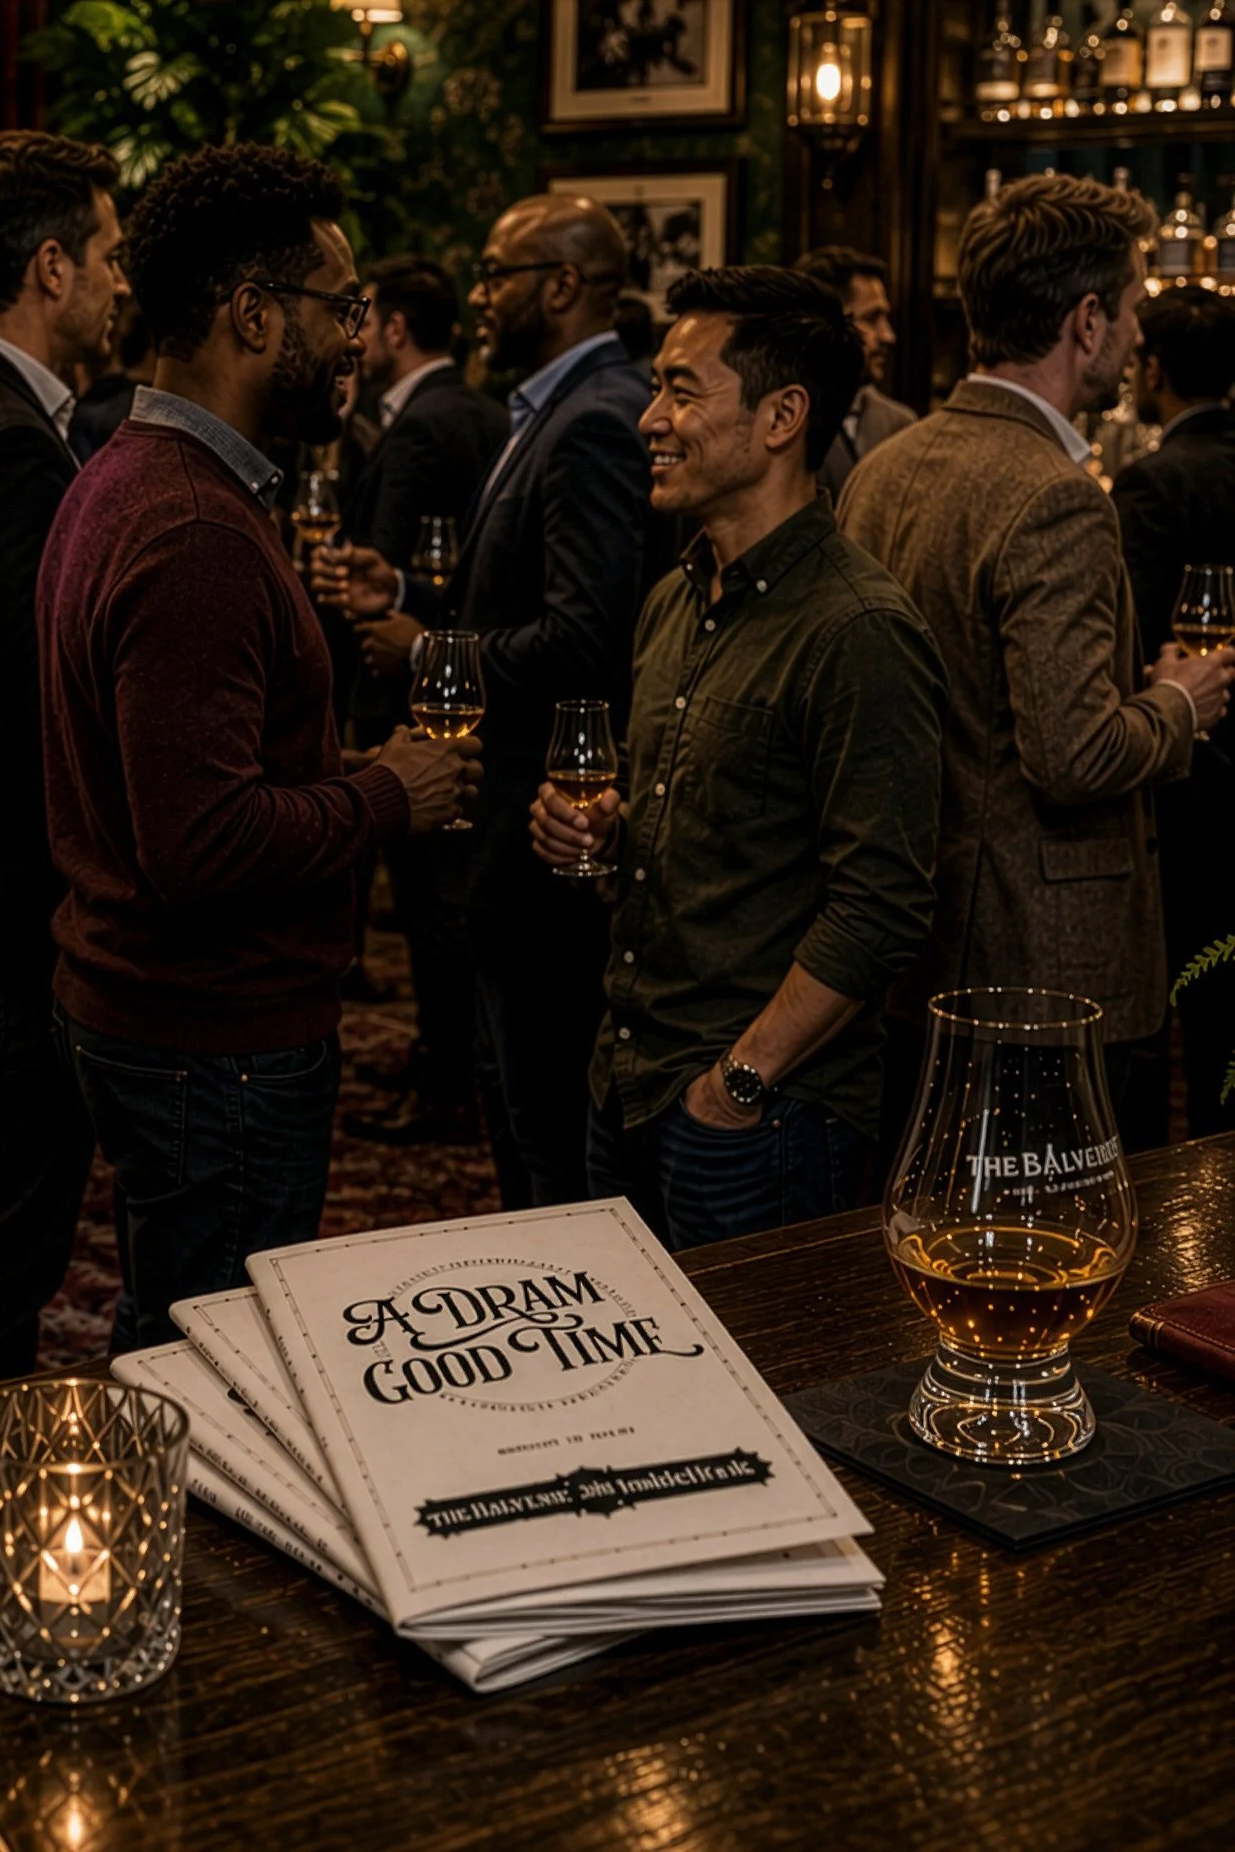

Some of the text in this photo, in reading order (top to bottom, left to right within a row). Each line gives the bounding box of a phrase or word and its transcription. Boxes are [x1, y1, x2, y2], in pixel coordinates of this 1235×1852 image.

[966, 1155, 1019, 1178] THE
[342, 1296, 415, 1346] A
[410, 1271, 607, 1352] DRAM
[362, 1345, 514, 1405] GOOD
[507, 1313, 705, 1372] TIME
